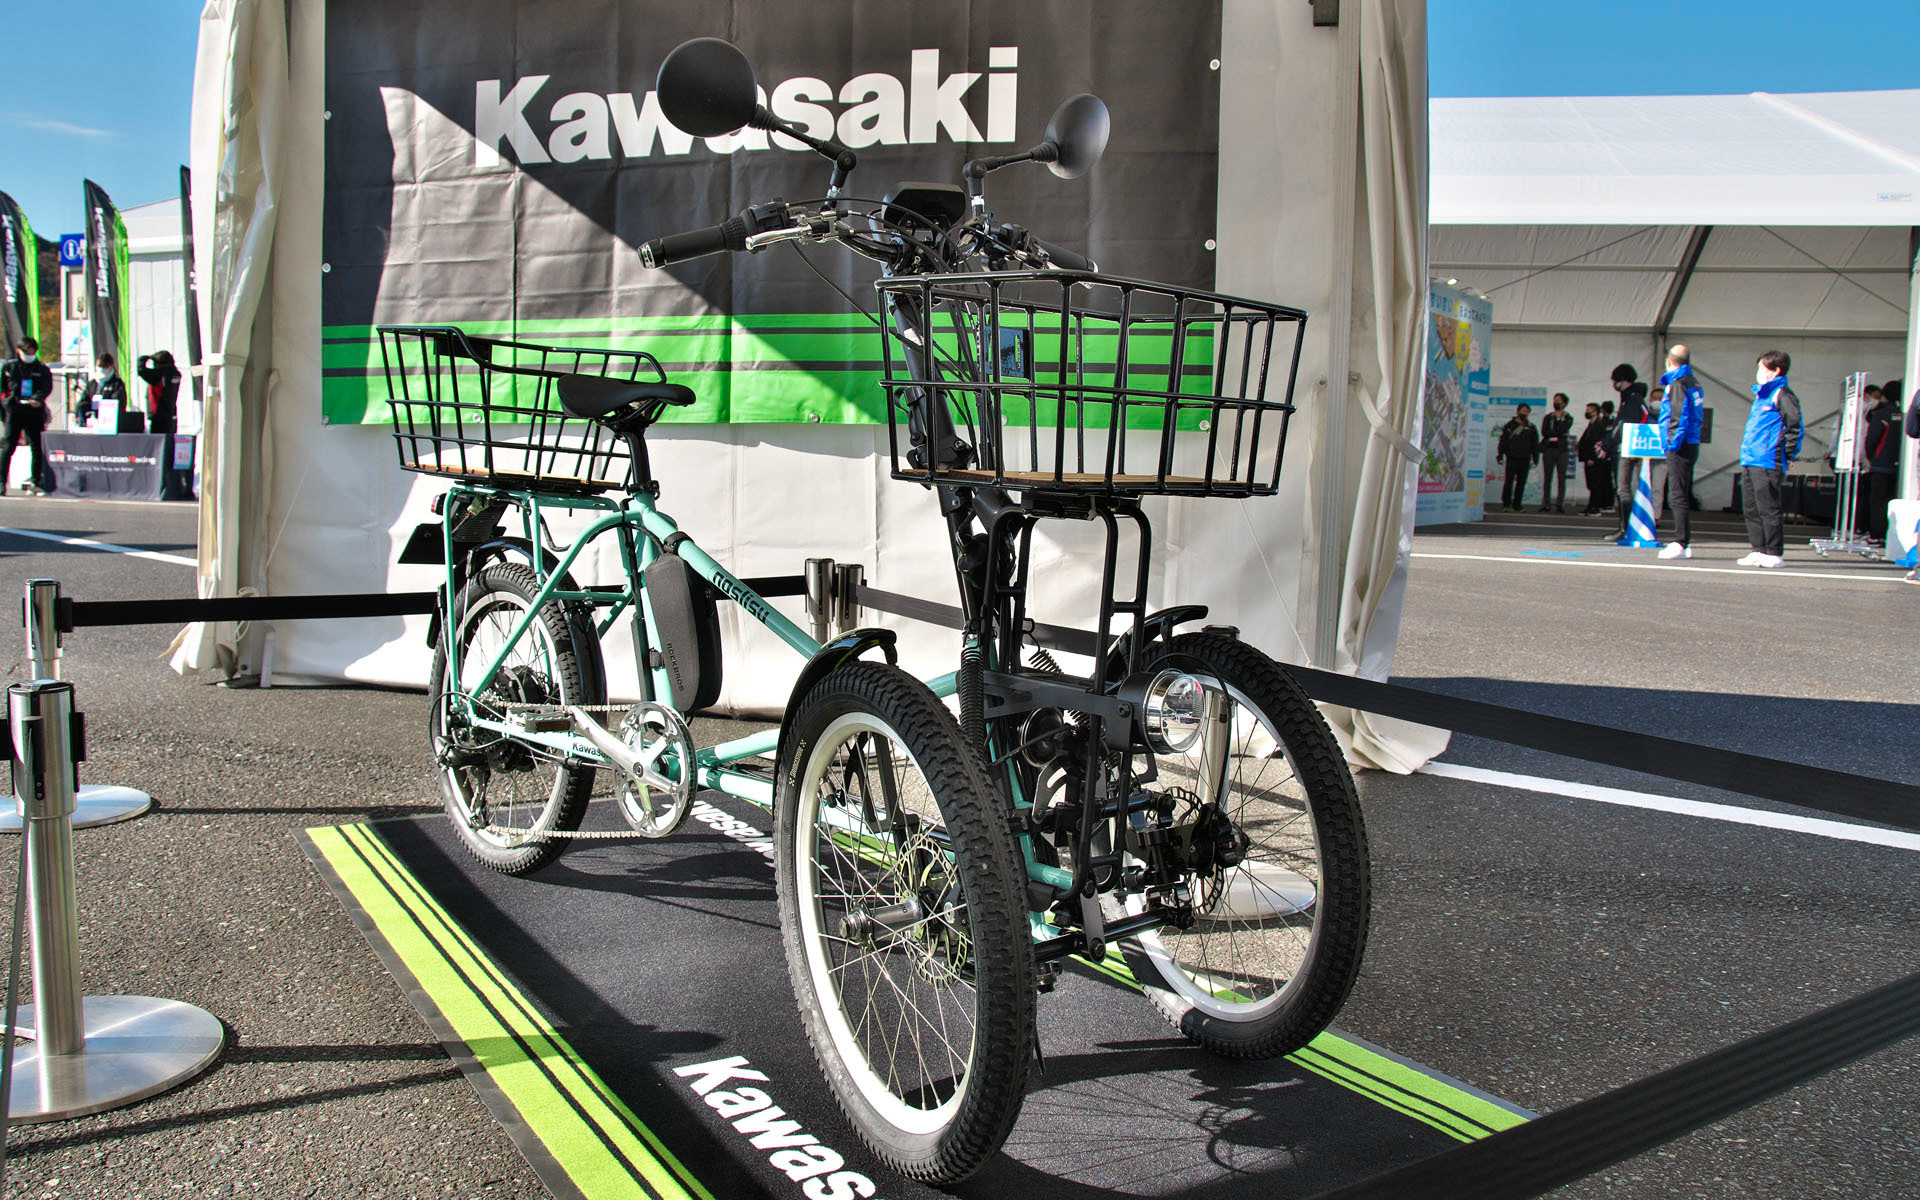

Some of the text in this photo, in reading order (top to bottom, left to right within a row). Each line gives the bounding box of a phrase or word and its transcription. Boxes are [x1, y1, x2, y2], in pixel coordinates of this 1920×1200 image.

[67, 455, 99, 463] TOYOTA
[100, 455, 128, 464] GAZOO
[129, 456, 156, 465] Racing
[667, 642, 684, 692] ROCKBROS
